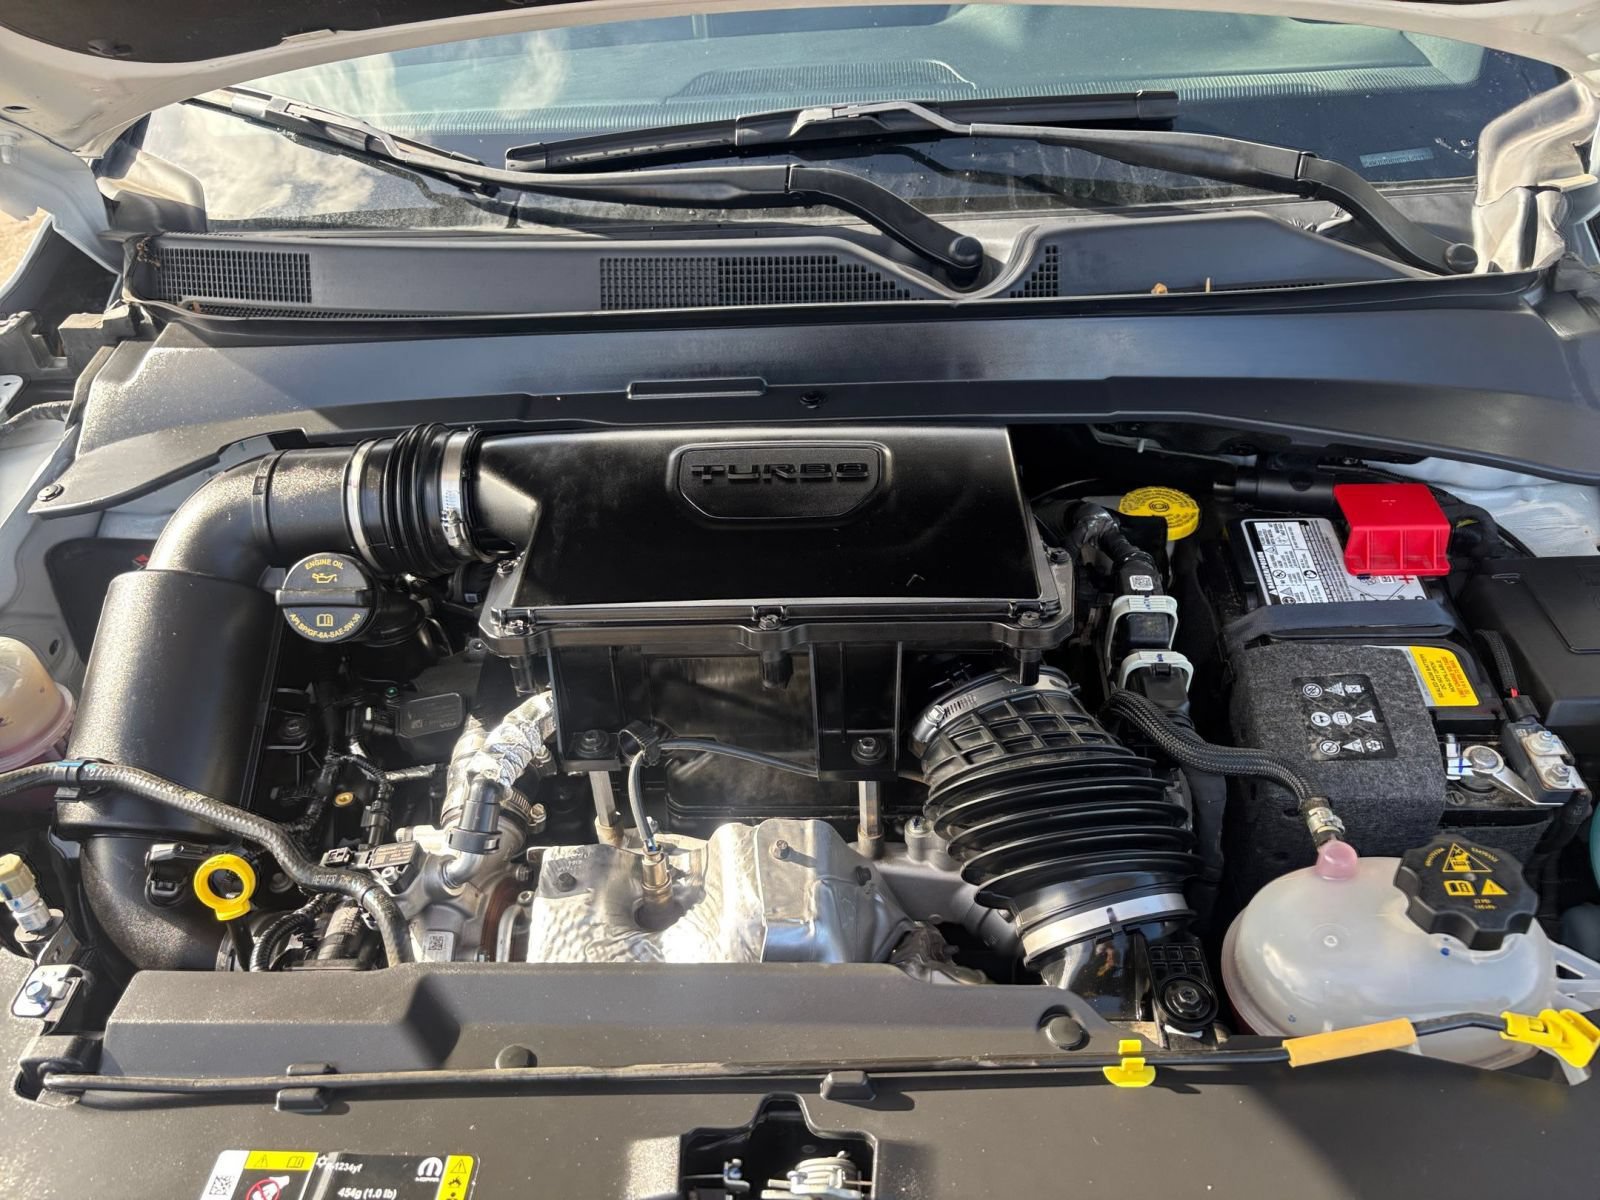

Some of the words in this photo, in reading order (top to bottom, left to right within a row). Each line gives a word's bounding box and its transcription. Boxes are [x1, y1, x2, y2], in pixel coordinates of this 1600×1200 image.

[305, 559, 331, 570] ENGINE
[332, 560, 344, 570] OIL
[289, 614, 300, 625] API
[337, 1187, 363, 1200] 454g
[363, 1188, 383, 1200] (1.0
[383, 1188, 397, 1199] lb)
